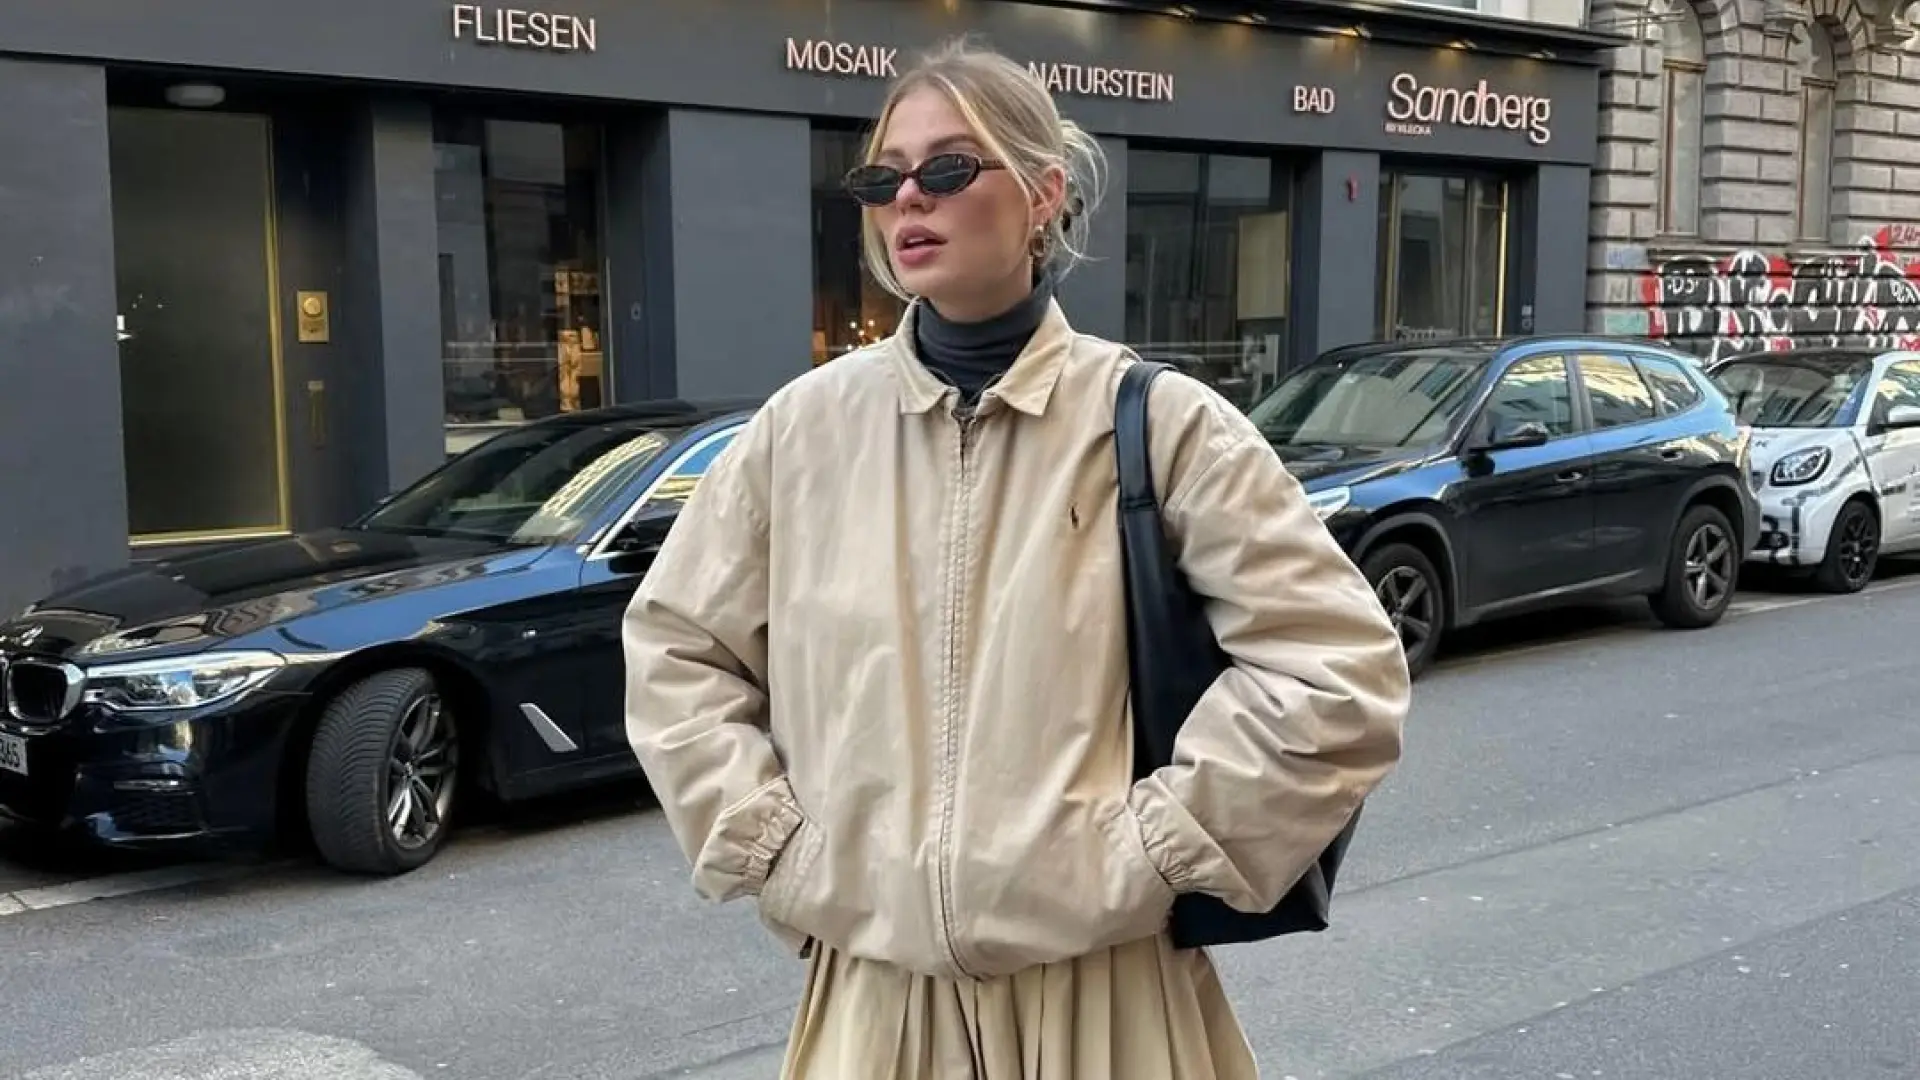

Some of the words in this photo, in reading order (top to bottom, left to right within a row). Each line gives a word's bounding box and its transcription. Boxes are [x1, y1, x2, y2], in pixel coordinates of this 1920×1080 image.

[453, 4, 596, 51] FLIESEN
[786, 37, 898, 77] MOSAIK
[1027, 60, 1174, 101] NATURSTEIN
[1293, 85, 1335, 113] BAD
[1387, 73, 1551, 144] Sandberg
